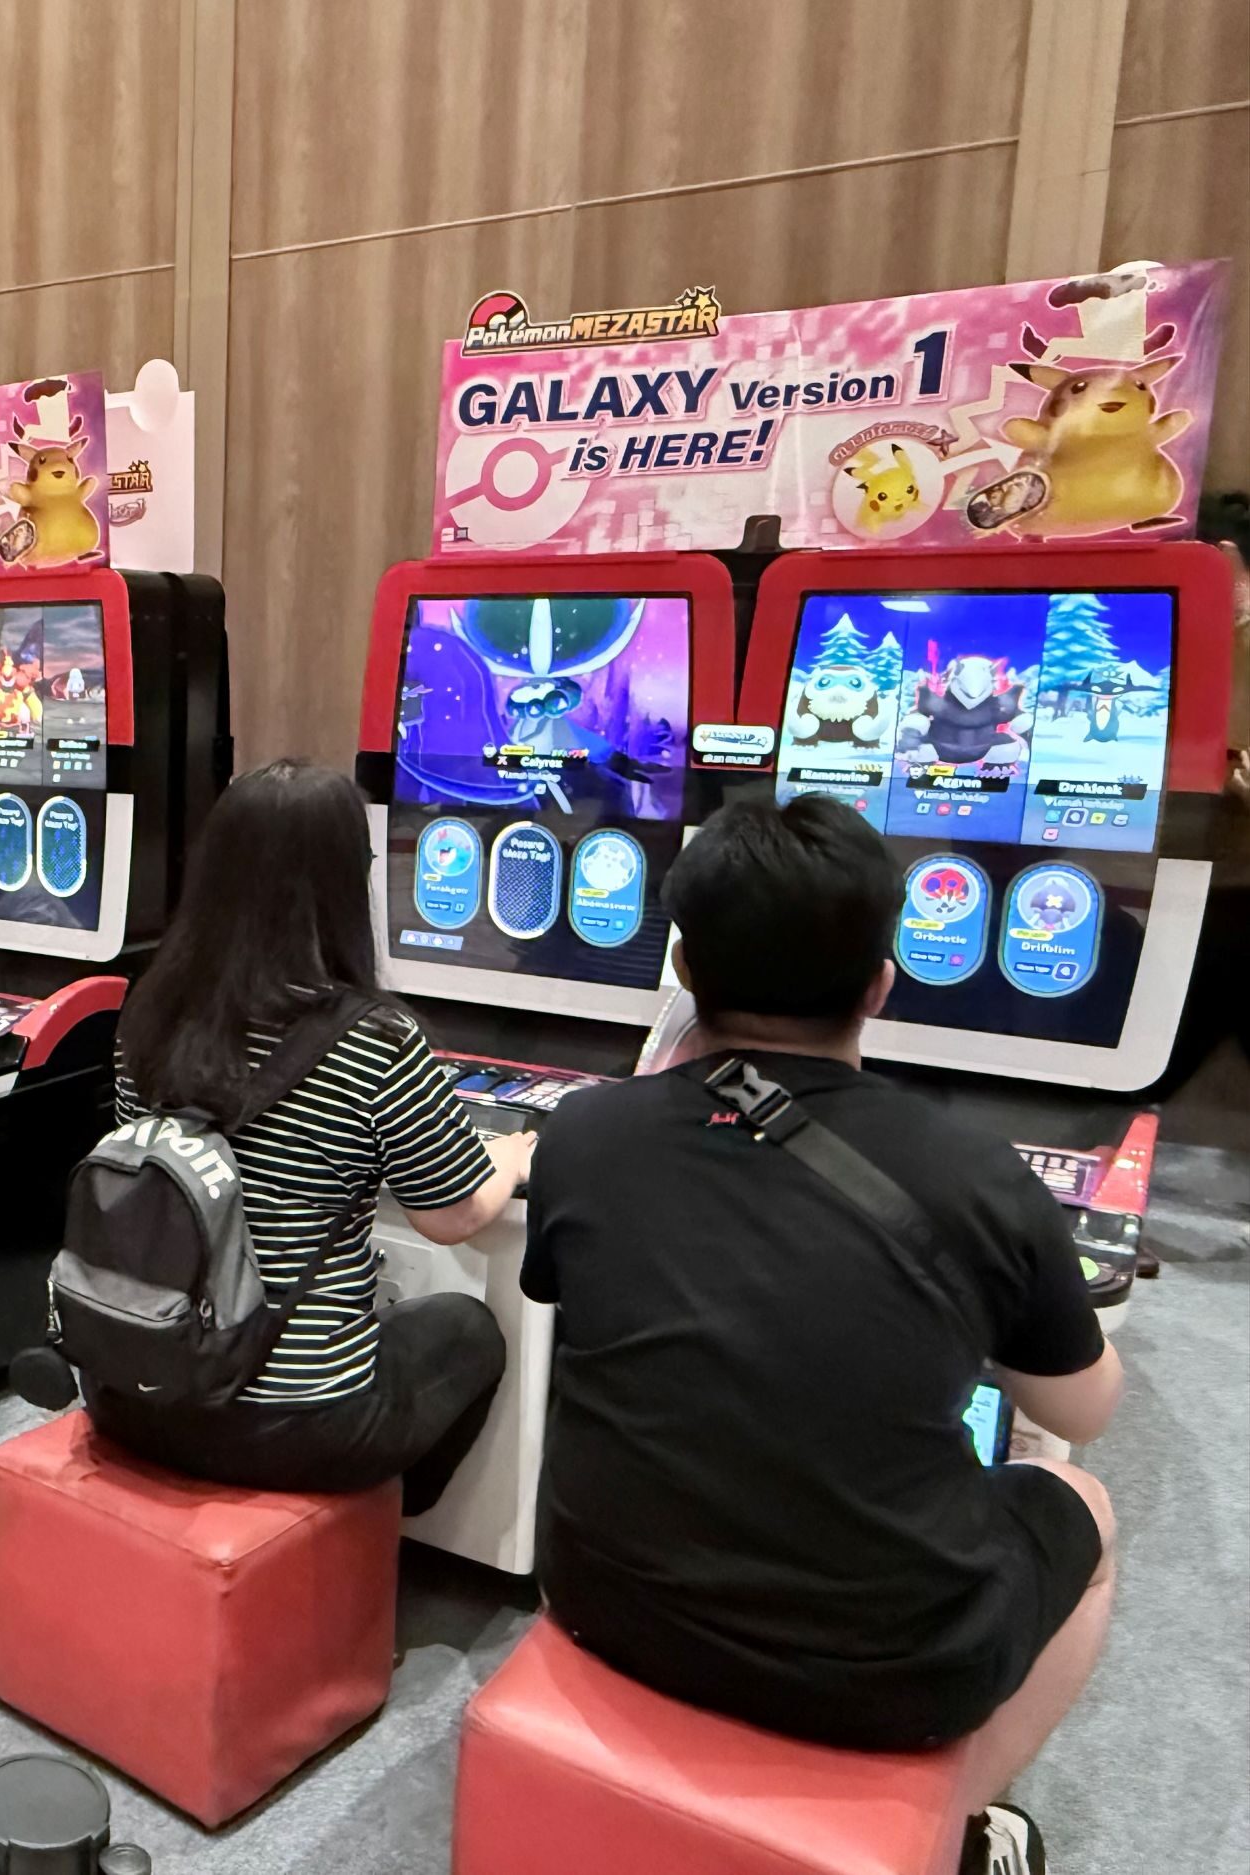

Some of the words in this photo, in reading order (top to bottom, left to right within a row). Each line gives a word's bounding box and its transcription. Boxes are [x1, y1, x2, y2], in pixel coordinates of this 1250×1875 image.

[467, 322, 570, 348] Pokémon
[570, 305, 719, 340] MEZASTAR
[458, 368, 718, 427] GALAXY
[730, 372, 895, 410] Version
[913, 331, 949, 396] 1
[568, 437, 610, 472] is
[618, 418, 776, 470] HERE!
[912, 931, 968, 945] Orbeetle
